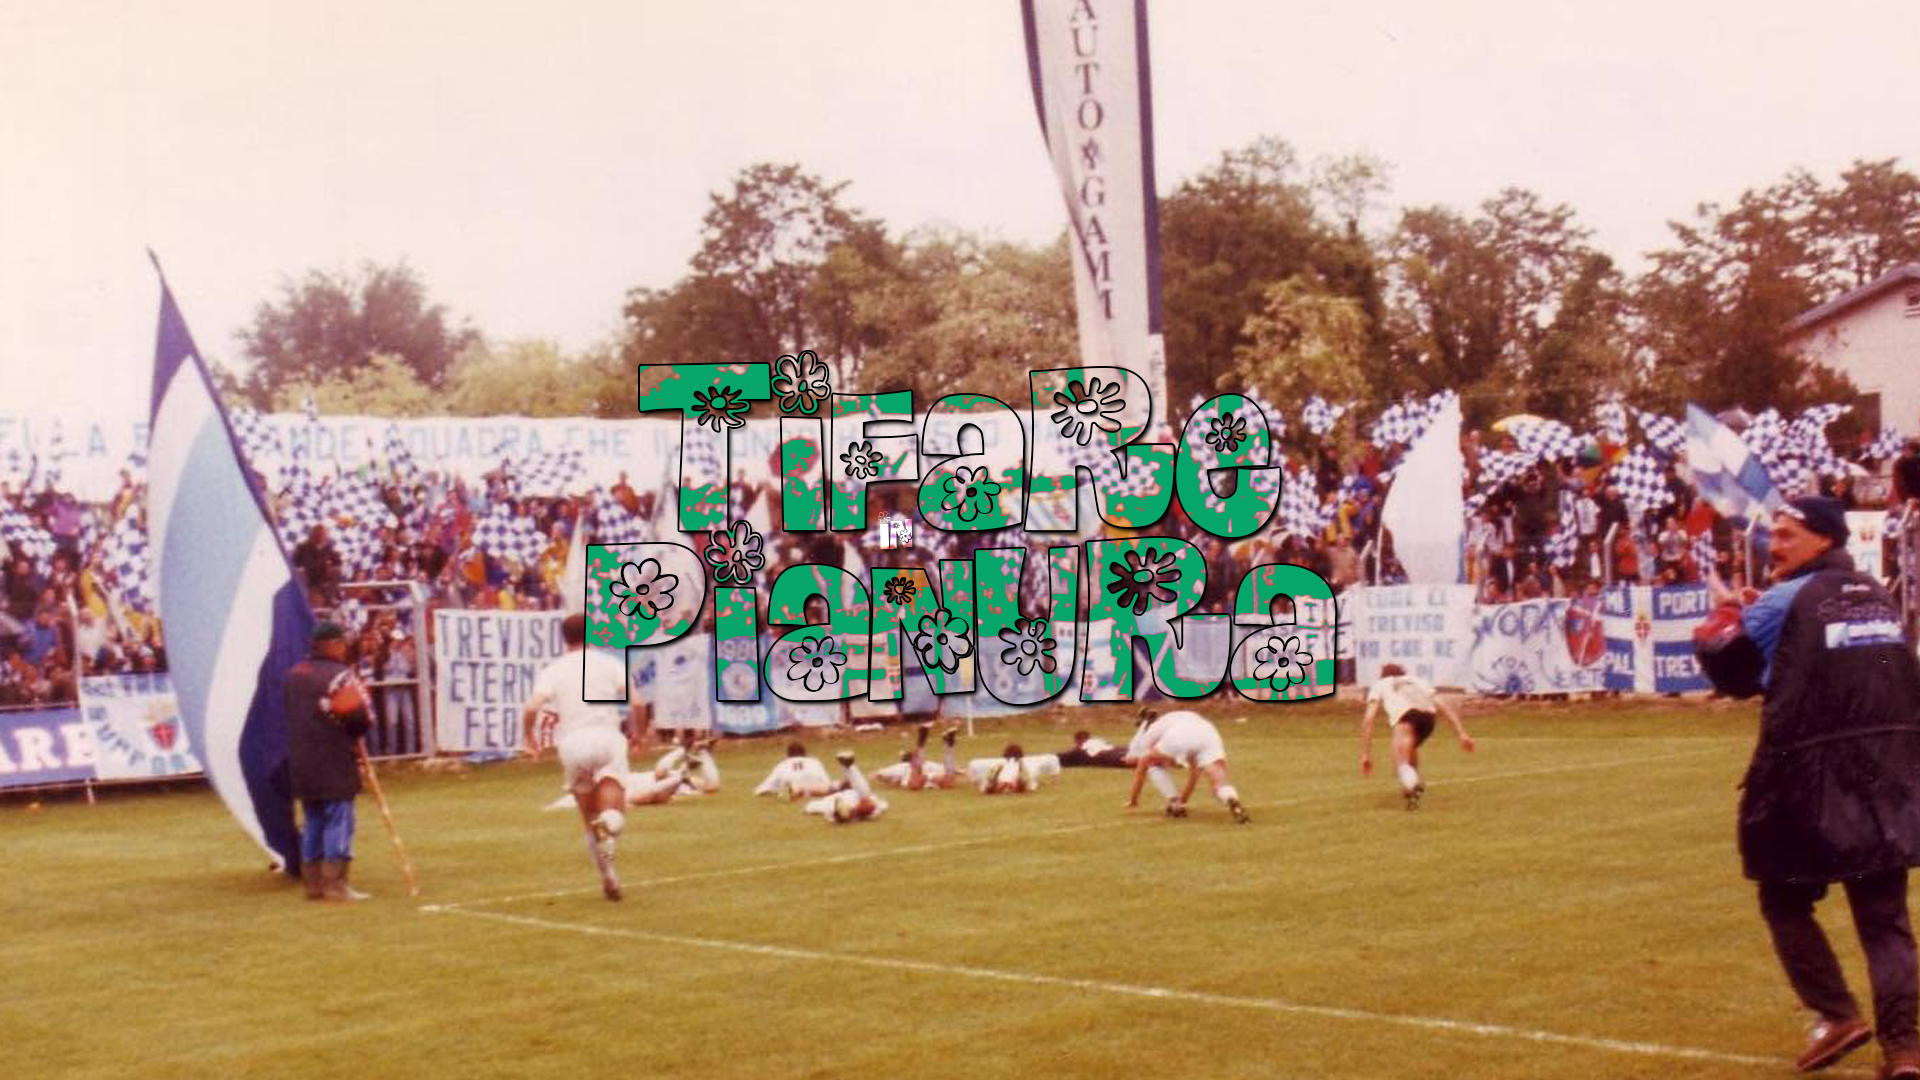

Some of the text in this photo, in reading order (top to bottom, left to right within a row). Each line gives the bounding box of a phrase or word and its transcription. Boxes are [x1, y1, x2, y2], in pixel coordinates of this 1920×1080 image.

[1069, 0, 1104, 131] AUTO
[437, 614, 565, 659] TREVISO
[450, 661, 549, 703] ETERN
